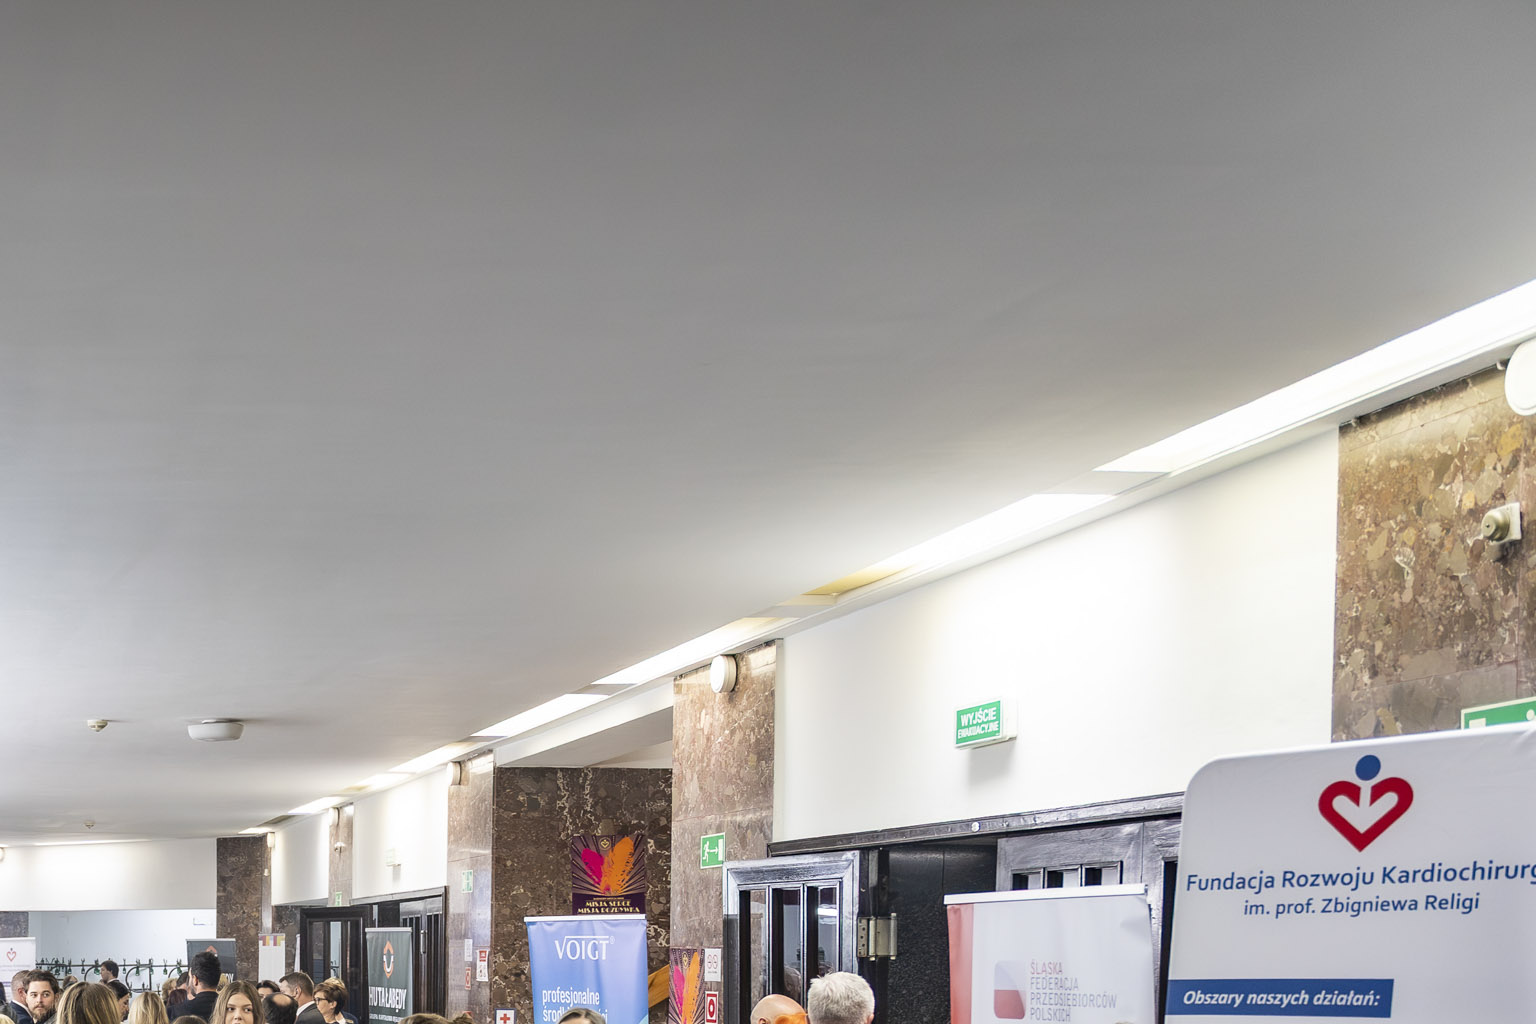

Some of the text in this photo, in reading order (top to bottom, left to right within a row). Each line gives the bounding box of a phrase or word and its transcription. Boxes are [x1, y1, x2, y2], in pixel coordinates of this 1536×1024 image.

[960, 707, 997, 727] WYJŚCIE
[1186, 870, 1276, 895] Fundacja
[1282, 866, 1375, 891] Rozwoju
[1243, 892, 1481, 919] im. prof. Zbigniewa Religi
[1030, 976, 1080, 991] FEDERACJA
[368, 986, 385, 1007] HUTA
[542, 986, 600, 1007] profesjonalne
[1183, 988, 1381, 1009] Obszary naszych działań:
[1030, 1007, 1072, 1022] POLSKICH
